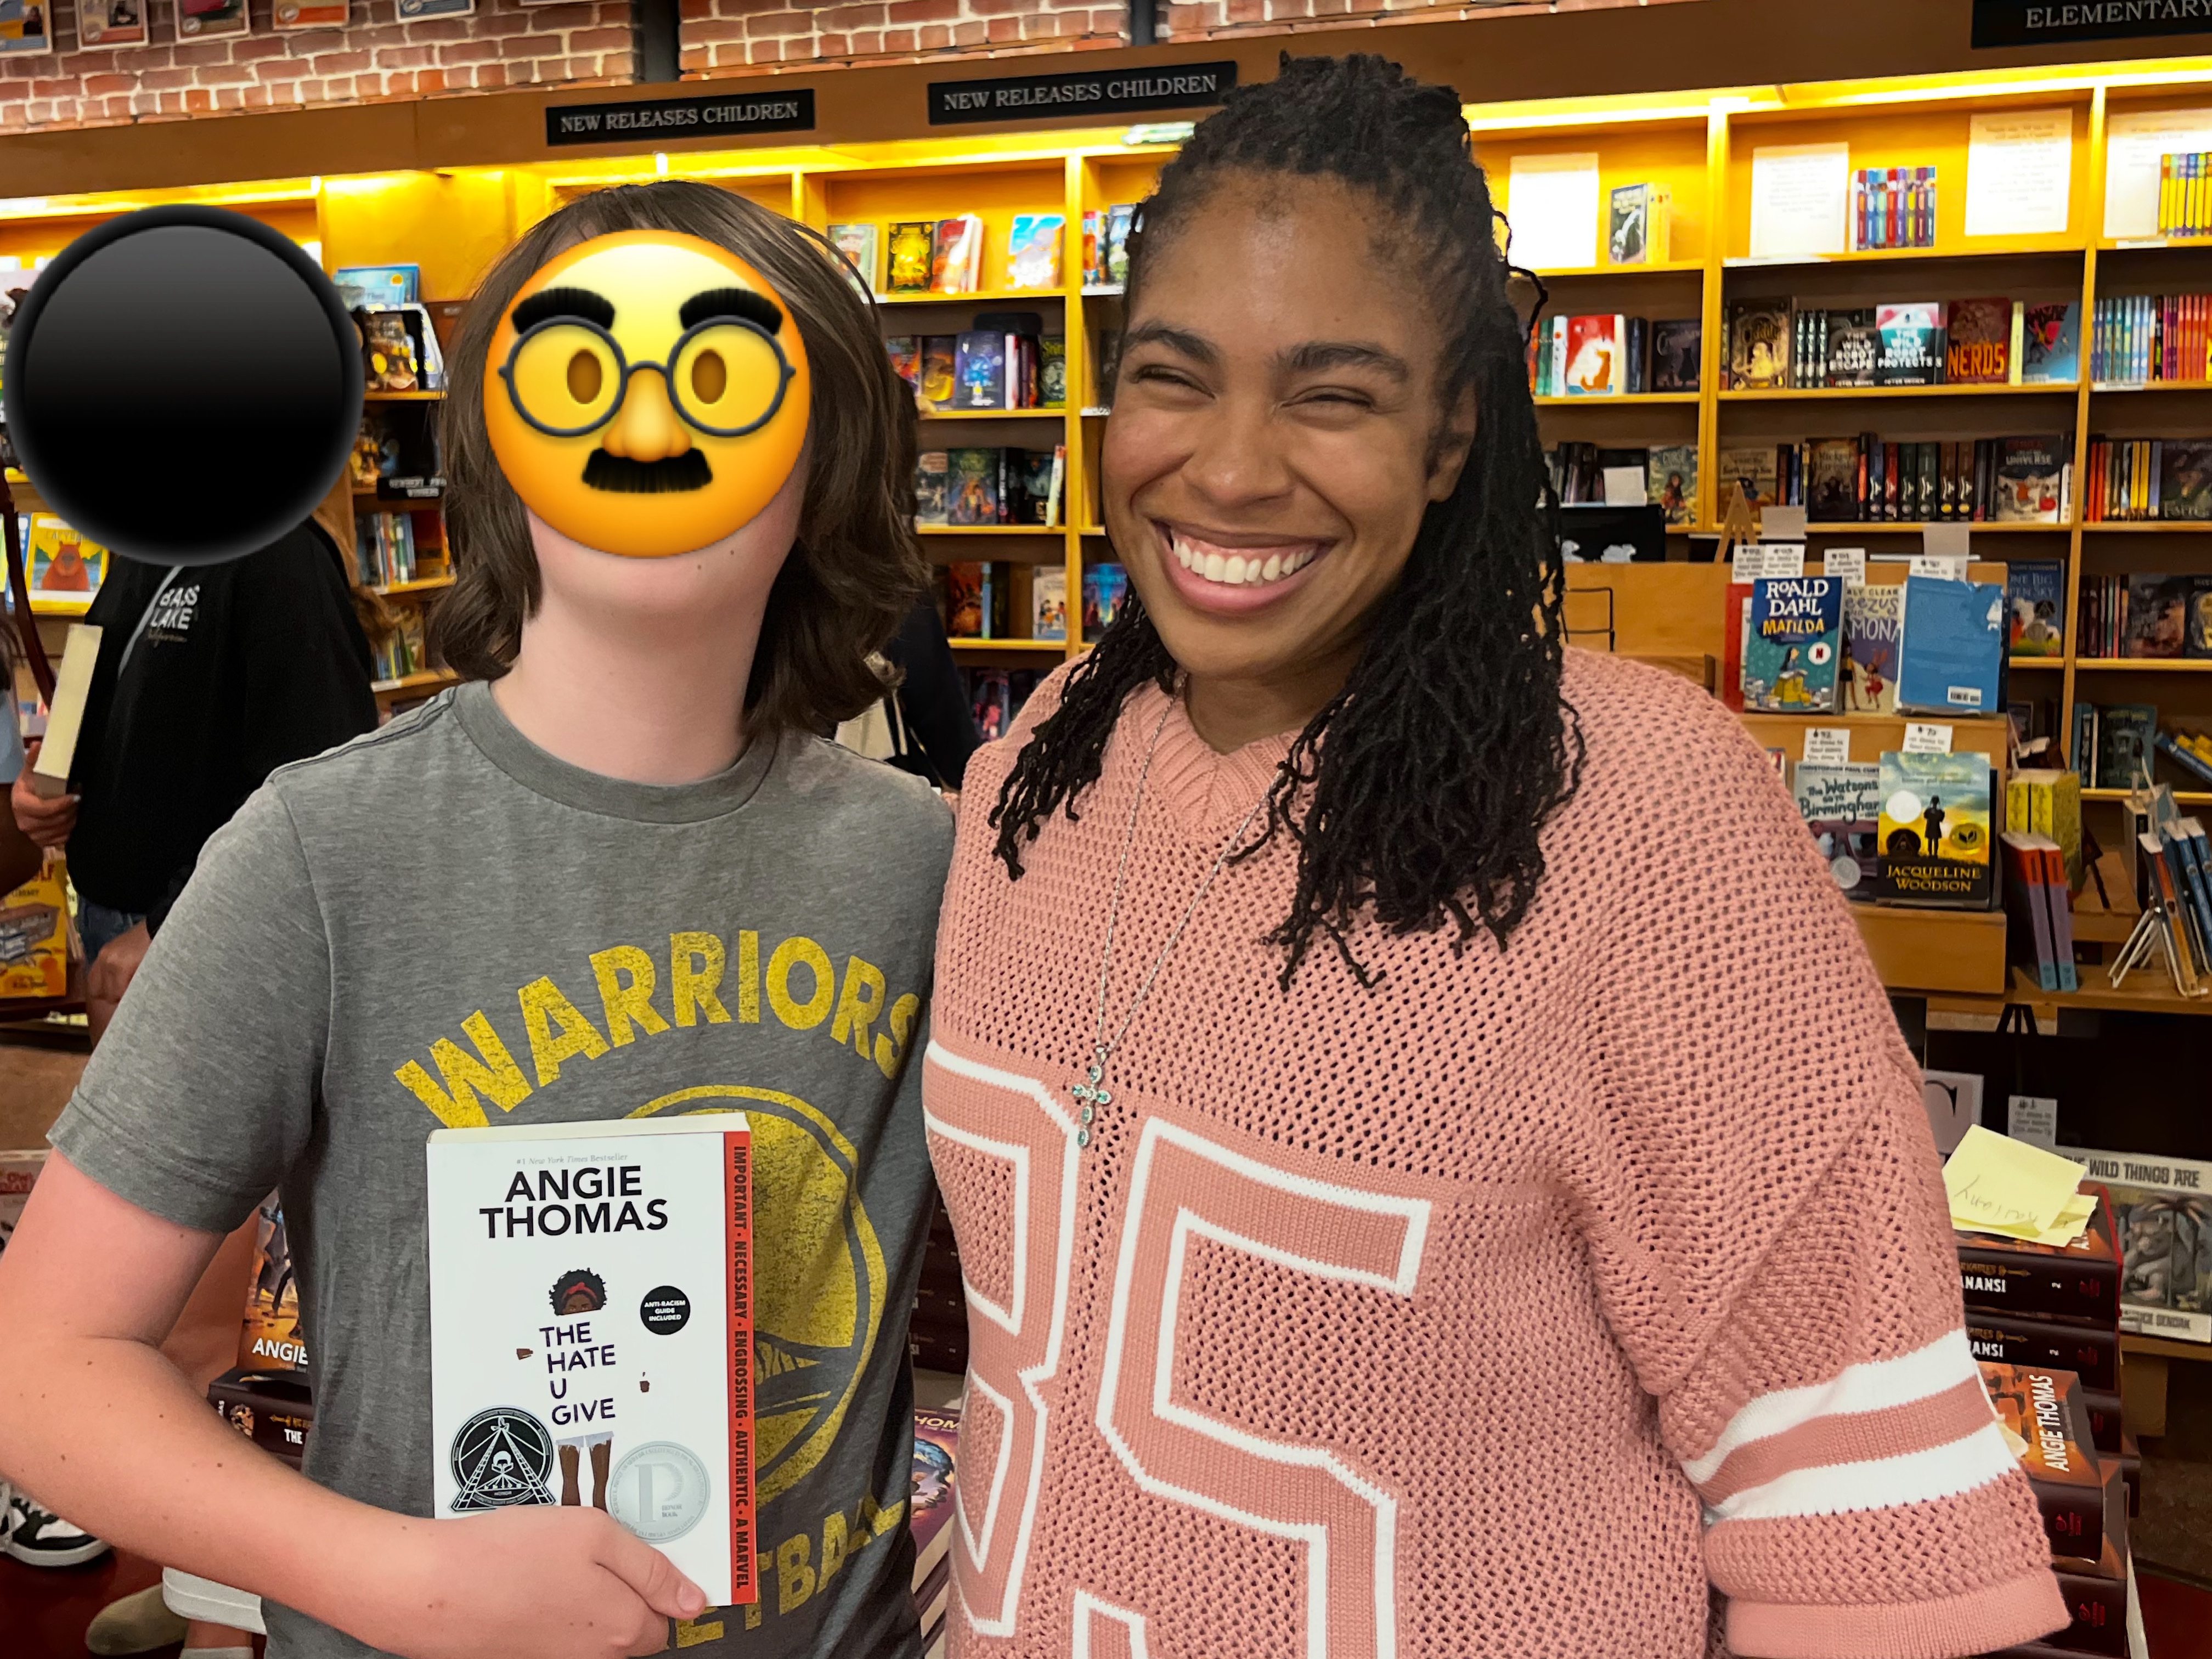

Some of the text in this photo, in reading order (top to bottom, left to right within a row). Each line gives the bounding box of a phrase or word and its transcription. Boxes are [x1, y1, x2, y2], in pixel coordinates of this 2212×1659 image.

[2025, 0, 2212, 29] ELEMENTARY
[944, 75, 1217, 110] NEW RELEASES CHILDREN
[561, 101, 798, 132] NEW RELEASES CHILDREN
[1829, 359, 1874, 371] ESCAPE
[1947, 342, 2004, 376] NERDS
[2006, 454, 2052, 466] UNIVERSE
[1765, 579, 1829, 599] ROALD
[150, 608, 193, 630] LAKE
[1769, 599, 1822, 617] DAHL
[1763, 617, 1825, 635] MATILDA
[1815, 648, 1824, 659] N
[1821, 777, 1878, 795] Watsons
[1886, 864, 1981, 879] JACQUELINE
[1896, 877, 1971, 892] WOODSON
[393, 929, 920, 1129] WARRIORS
[590, 1153, 628, 1162] Bestseller
[505, 1165, 642, 1202] ANGIE
[2089, 1159, 2119, 1178] WILD
[2124, 1163, 2169, 1184] THINGS
[2174, 1169, 2199, 1188] ARE
[479, 1199, 668, 1238] THOMAS
[539, 1322, 592, 1347] THE
[252, 1337, 308, 1365] ANGIE
[548, 1344, 616, 1373] HATE
[1971, 1342, 2004, 1358] ANSI
[733, 1147, 749, 1589] IMPORTANT NECESSARY ENGROSSING AUTHENTIC A MARVEL
[551, 1378, 567, 1399] U
[551, 1398, 616, 1425] GIVE
[2029, 1375, 2070, 1472] ANGIE THOMAS
[284, 1429, 303, 1445] THE
